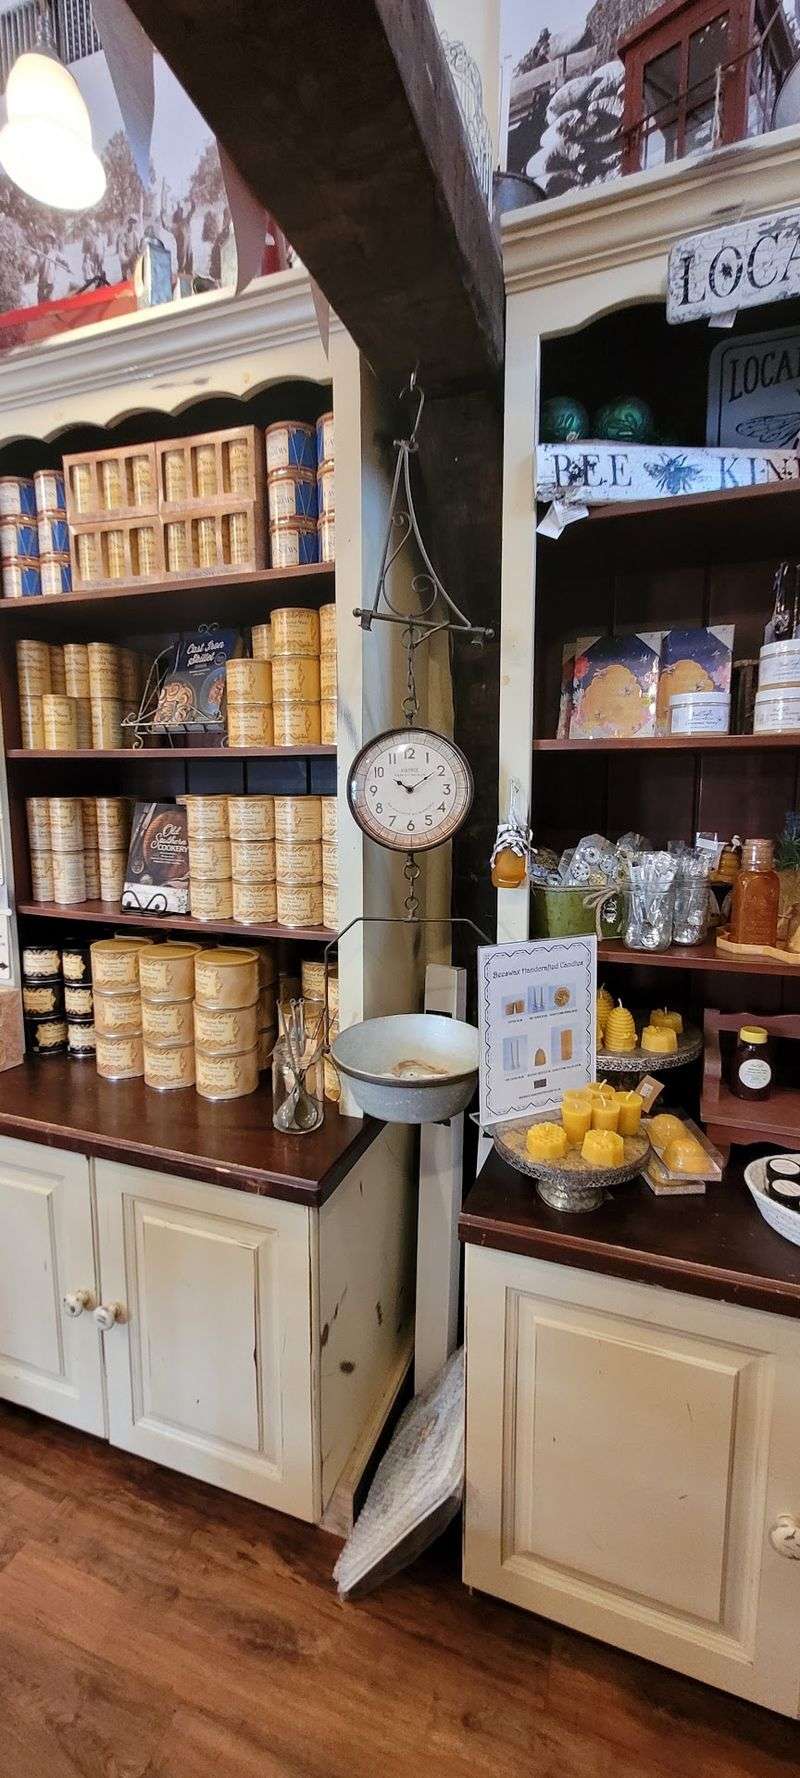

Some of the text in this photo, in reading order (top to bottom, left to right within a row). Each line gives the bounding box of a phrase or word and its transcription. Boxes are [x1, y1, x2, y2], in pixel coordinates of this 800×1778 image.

[729, 348, 800, 403] LOCA
[553, 453, 800, 492] BEE KIN
[388, 753, 397, 765] 11
[404, 748, 416, 760] 12
[425, 752, 430, 764] 1
[374, 766, 385, 778] 10
[436, 765, 446, 777] 2
[369, 785, 378, 797] 9
[442, 784, 451, 796] 3
[375, 802, 383, 814] 8
[436, 801, 446, 813] 4
[388, 815, 397, 827] 7
[406, 819, 415, 832] 6
[424, 815, 433, 827] 5
[162, 823, 182, 837] Old
